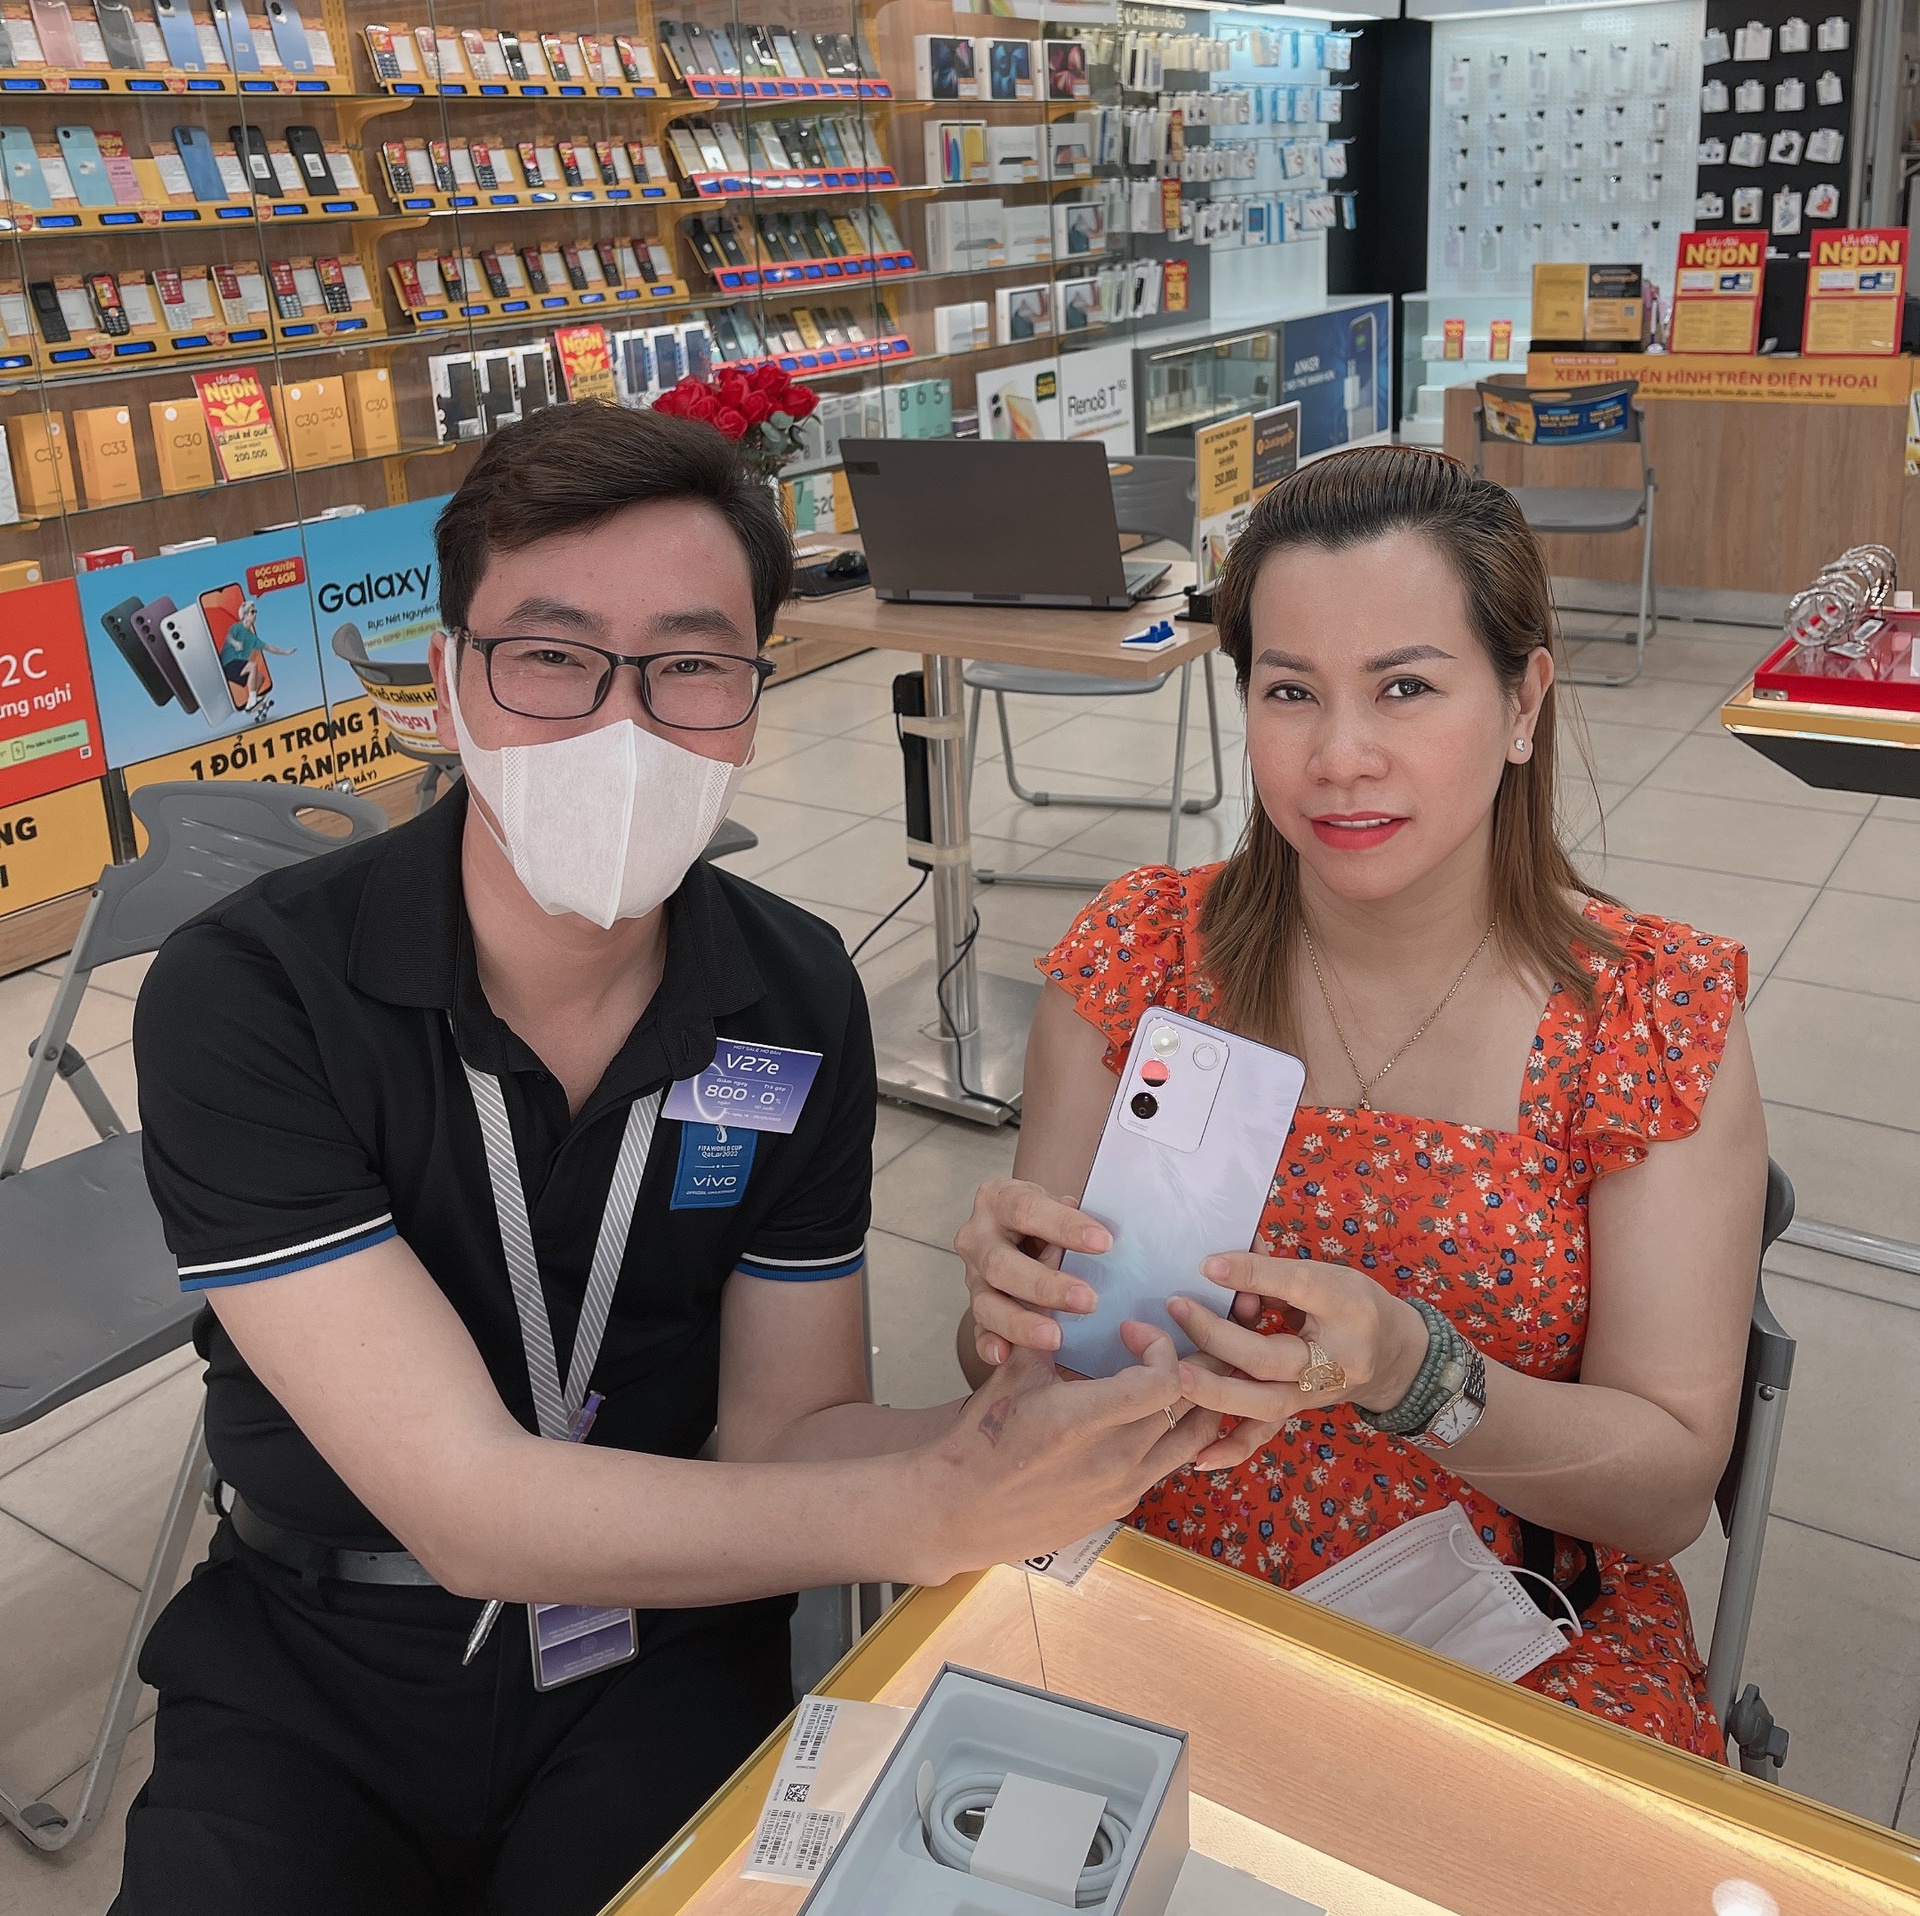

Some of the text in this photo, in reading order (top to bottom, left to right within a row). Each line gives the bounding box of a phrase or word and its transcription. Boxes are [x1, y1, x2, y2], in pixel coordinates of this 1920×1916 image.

[1555, 368, 1591, 383] XEM
[1666, 368, 1712, 385] HÌNH
[1717, 369, 1763, 386] TRÊN
[1767, 369, 1813, 389] ĐIỆN
[1818, 373, 1878, 391] THOẠI
[365, 397, 389, 413] C30
[294, 412, 319, 428] C30
[99, 440, 128, 457] C33
[173, 432, 202, 449] C30
[34, 445, 63, 463] C33
[318, 563, 432, 613] Galaxy
[385, 613, 402, 625] Nét
[402, 603, 435, 622] Nguyên
[390, 709, 431, 731] Ngay
[191, 759, 204, 781] 1
[210, 735, 258, 777] ĐỔI
[263, 738, 276, 759] 1
[280, 712, 364, 752] TRONG
[725, 1052, 780, 1076] V27e
[704, 1084, 748, 1102] 800
[692, 1174, 737, 1188] vivo
